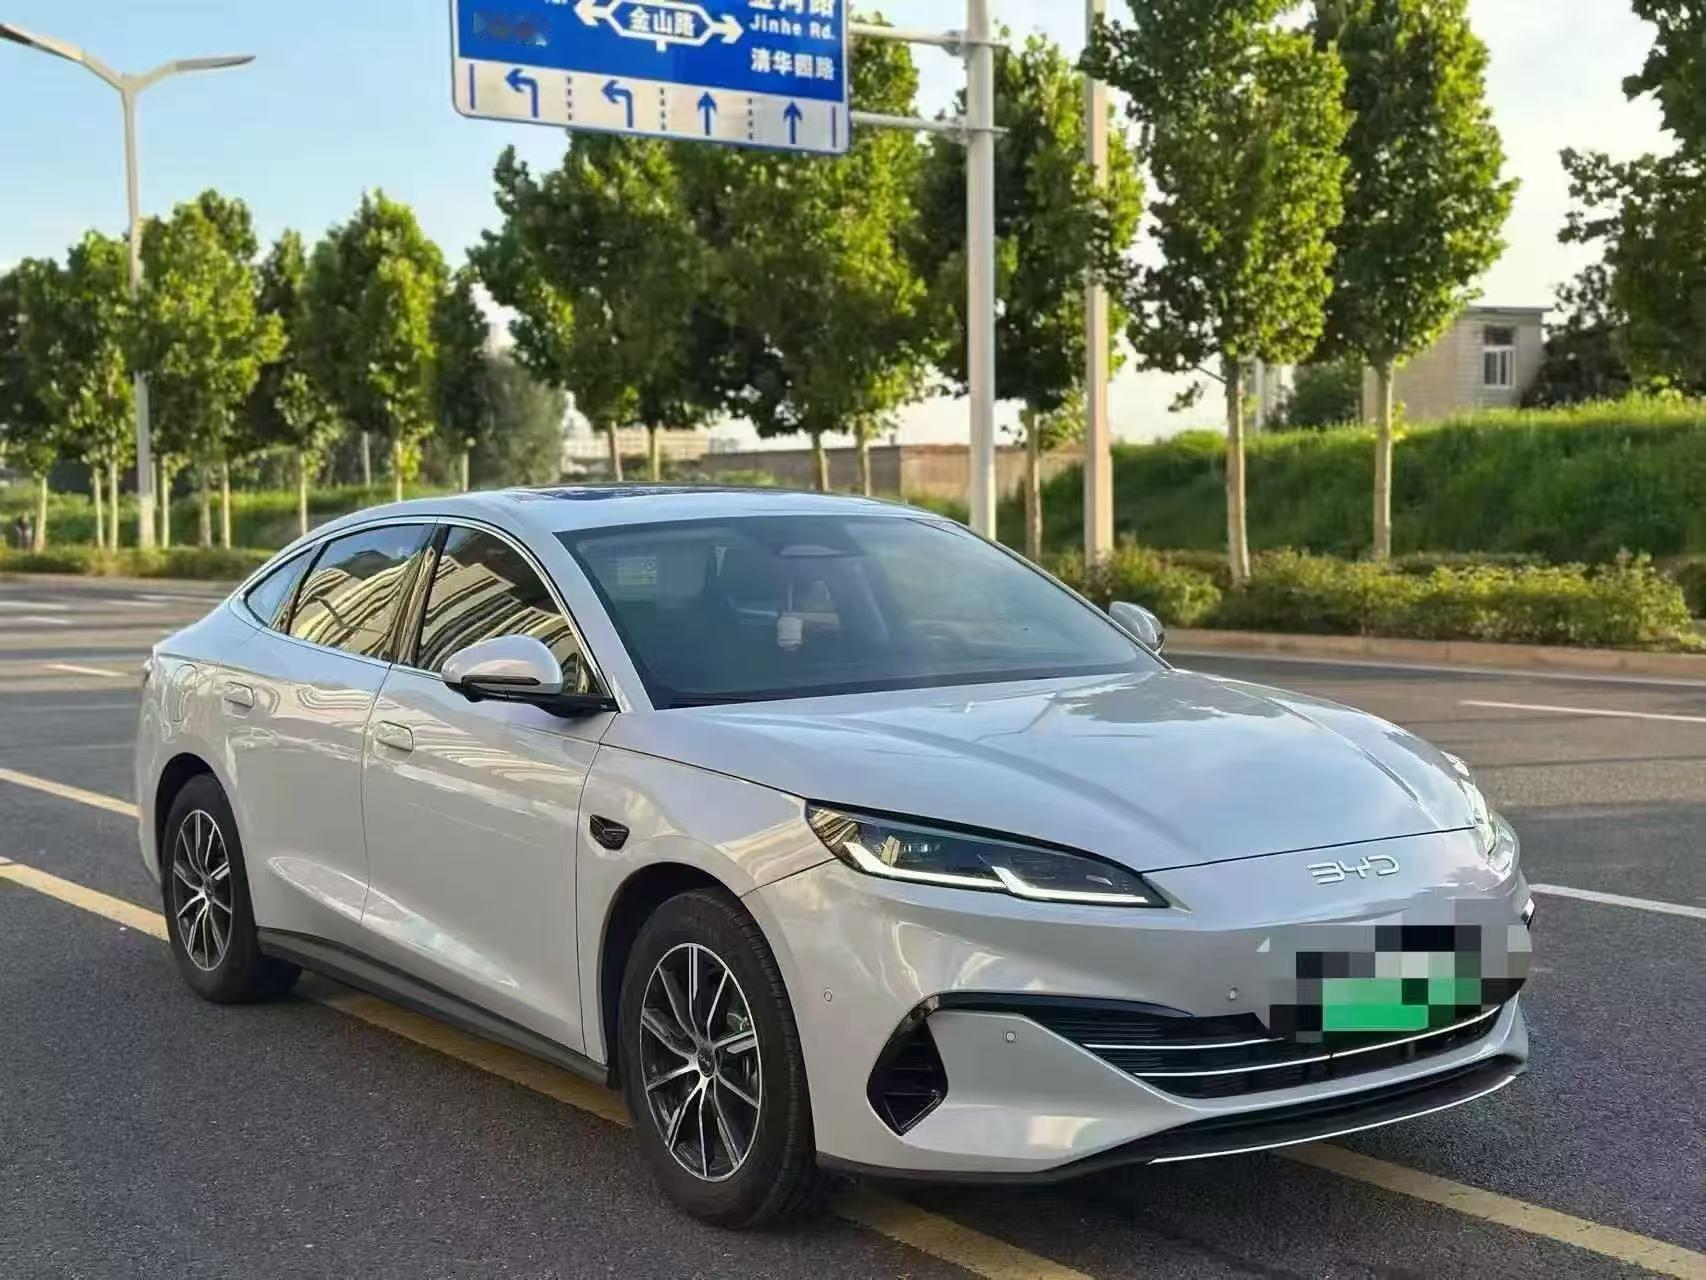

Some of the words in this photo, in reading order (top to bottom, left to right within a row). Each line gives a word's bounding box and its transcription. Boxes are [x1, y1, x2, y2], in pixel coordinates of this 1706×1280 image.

[630, 6, 694, 37] 金山路
[749, 14, 802, 36] Jinhe
[1307, 855, 1400, 884] BYD
